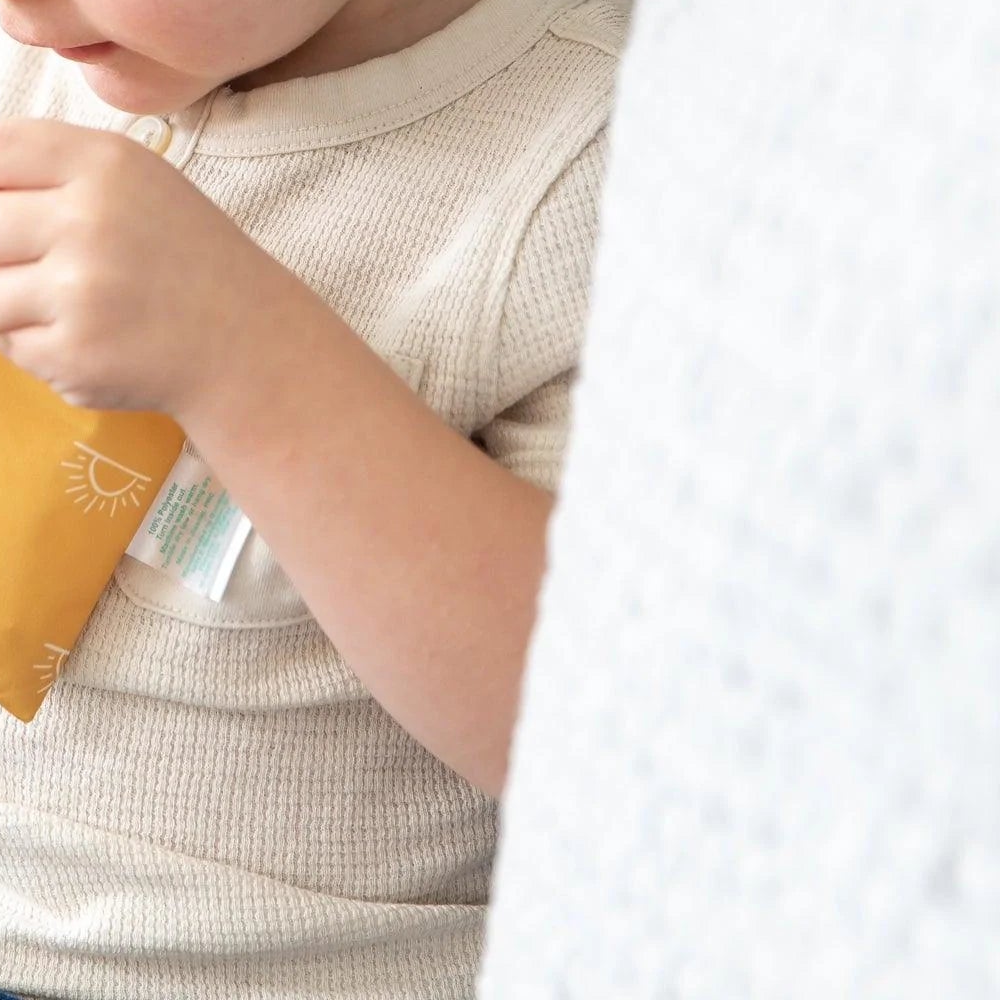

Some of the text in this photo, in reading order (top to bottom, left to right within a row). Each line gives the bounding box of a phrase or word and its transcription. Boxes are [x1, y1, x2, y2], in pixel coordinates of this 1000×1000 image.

[147, 482, 179, 535] 100% Polyester
[156, 524, 167, 539] Turn
